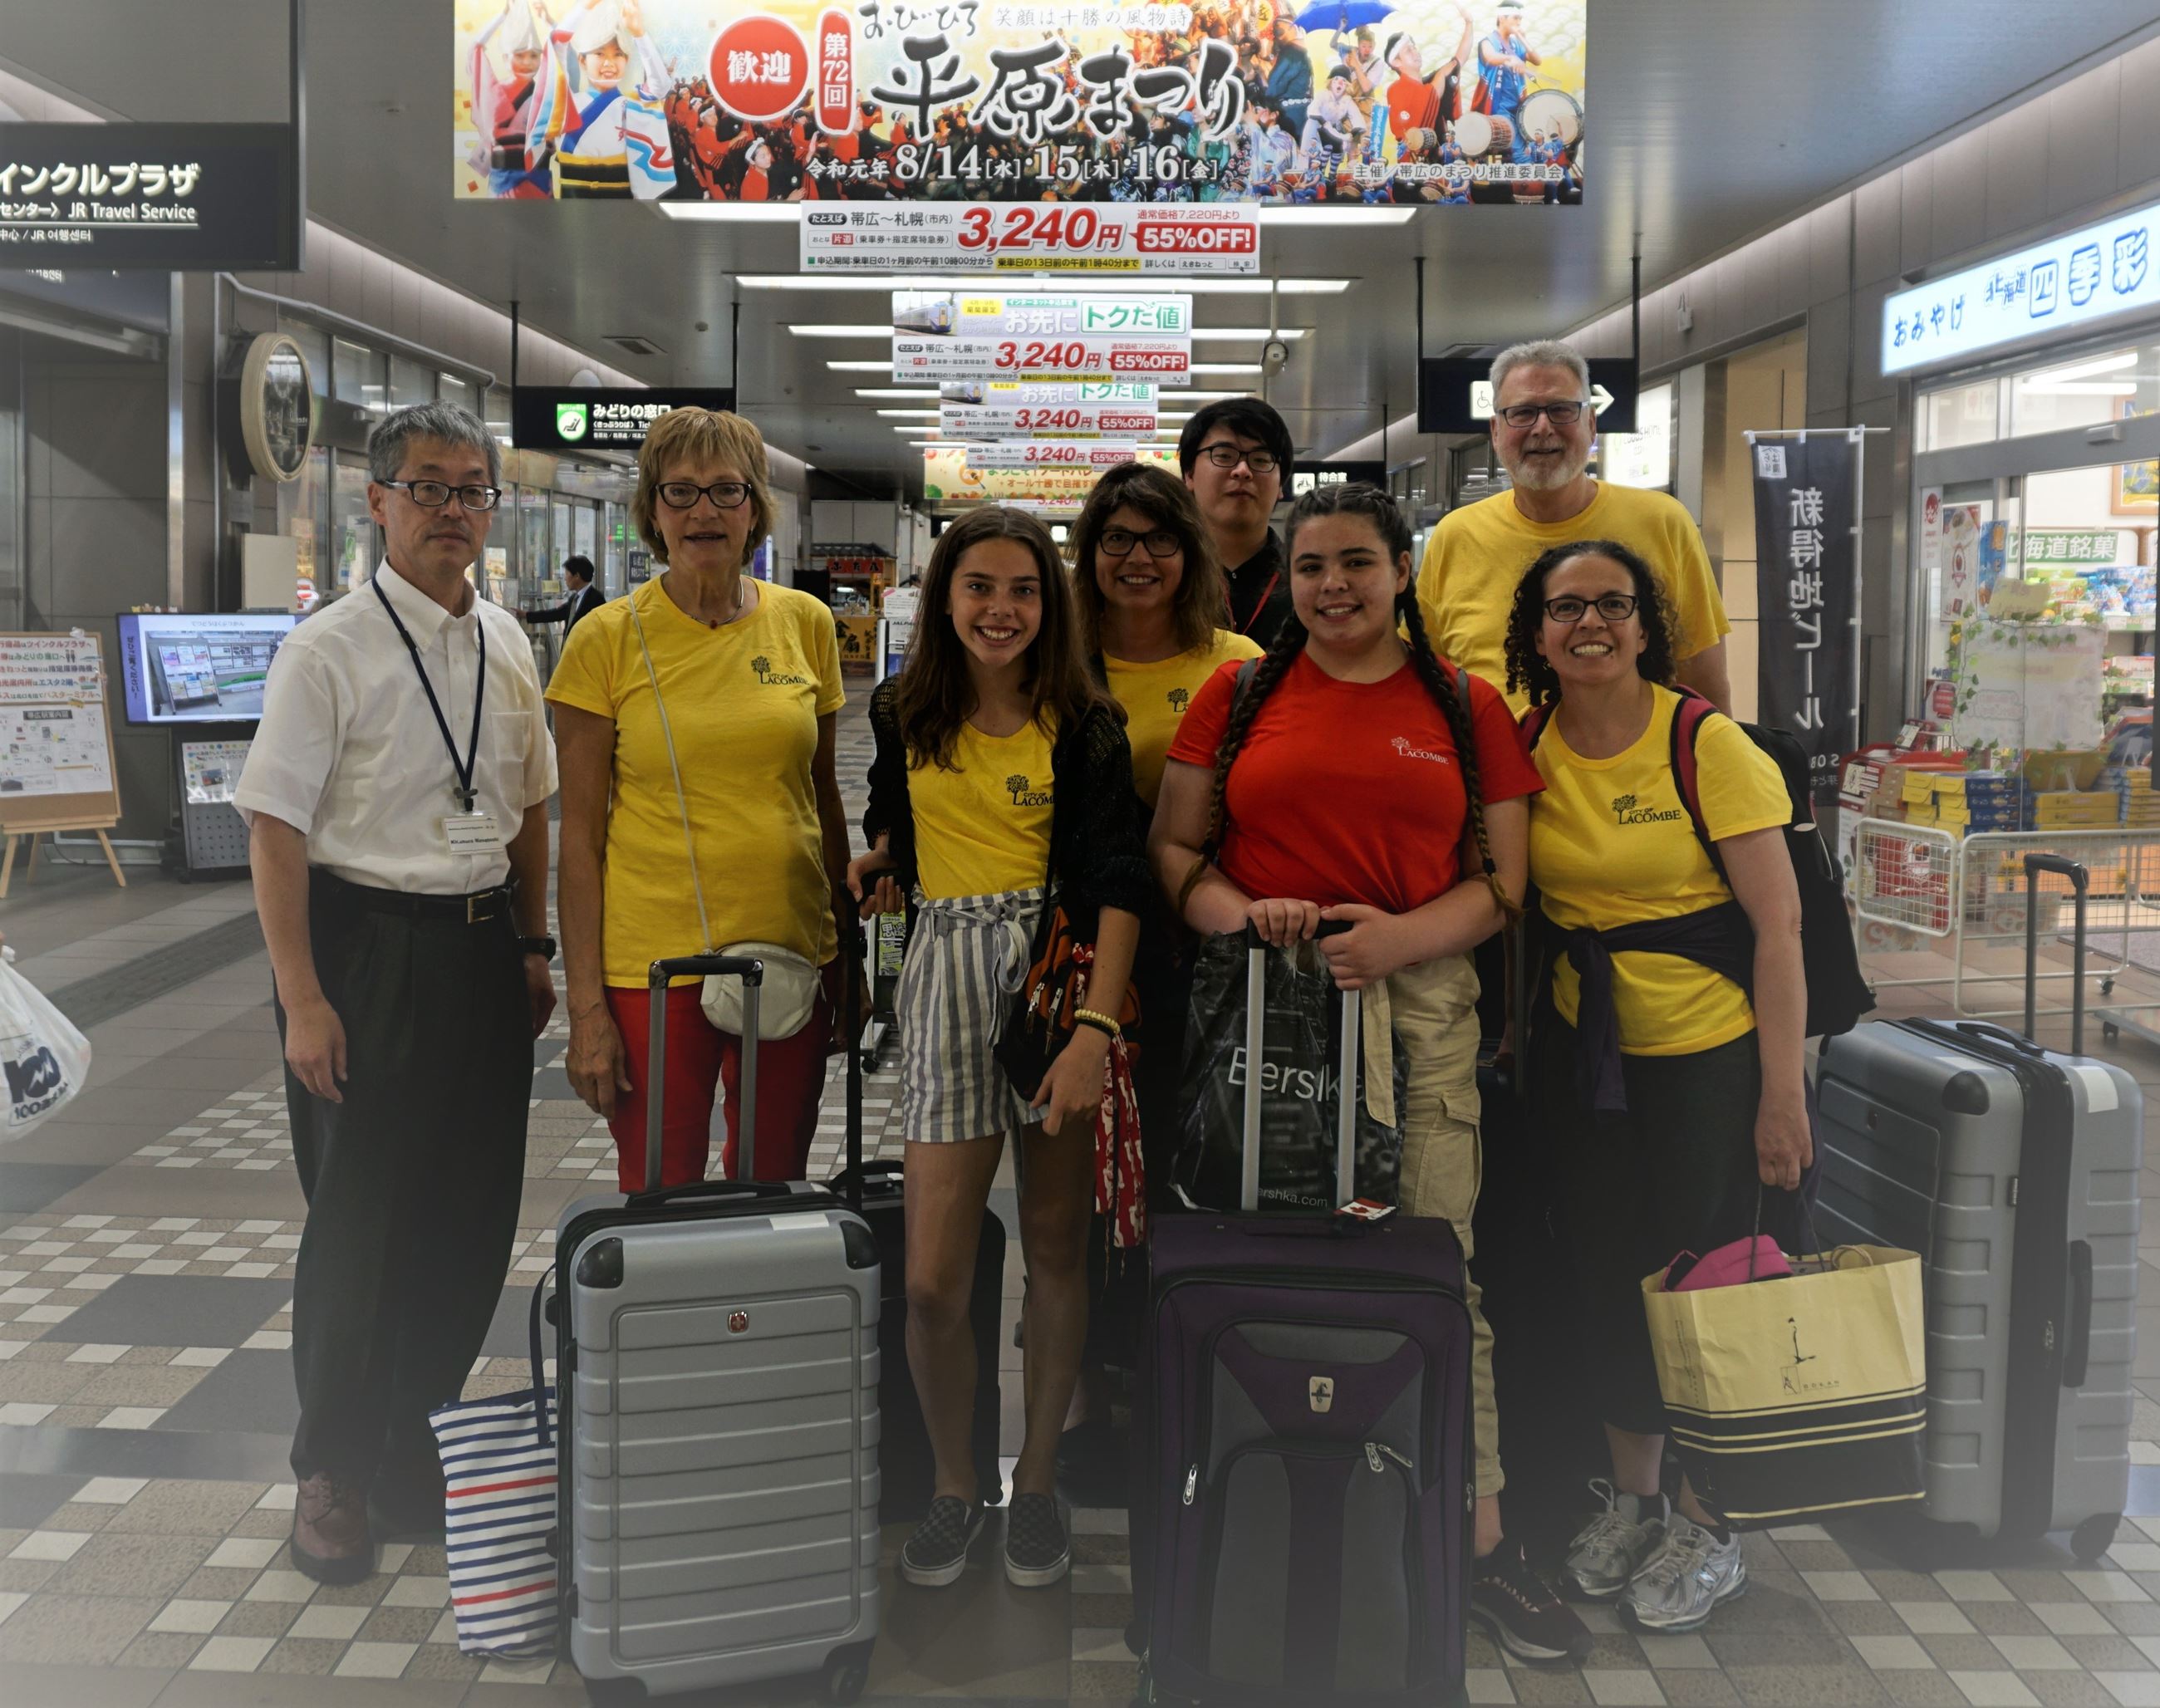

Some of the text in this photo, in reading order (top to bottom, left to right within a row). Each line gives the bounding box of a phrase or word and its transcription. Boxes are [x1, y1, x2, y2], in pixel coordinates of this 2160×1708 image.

[997, 7, 1189, 27] 笑顔は十勝の風物詩
[727, 50, 791, 84] 歓迎
[822, 32, 849, 108] 第72回
[871, 35, 1240, 140] 平原まつり
[805, 159, 890, 179] 令和元年
[68, 202, 86, 219] JR
[91, 202, 136, 219] Travel
[140, 202, 196, 220] Service
[812, 214, 844, 223] たとえば
[1137, 209, 1240, 220] 通常価格7,220円より
[31, 230, 45, 241] JR
[832, 234, 852, 244] 片道
[958, 207, 1123, 253] 3,240円
[1143, 227, 1251, 249] 55%OFF!
[1145, 258, 1176, 267] 詳しくは
[1986, 270, 2027, 306] 北海道
[1005, 309, 1078, 335] お先に
[994, 341, 1102, 371] 3,240円
[1115, 354, 1186, 369] 55%OFF!
[1014, 409, 1092, 429] 3,240円
[1102, 418, 1153, 428] 55%OFF!
[1398, 746, 1449, 764] LACOMBE
[1618, 810, 1681, 824] LACOMBE
